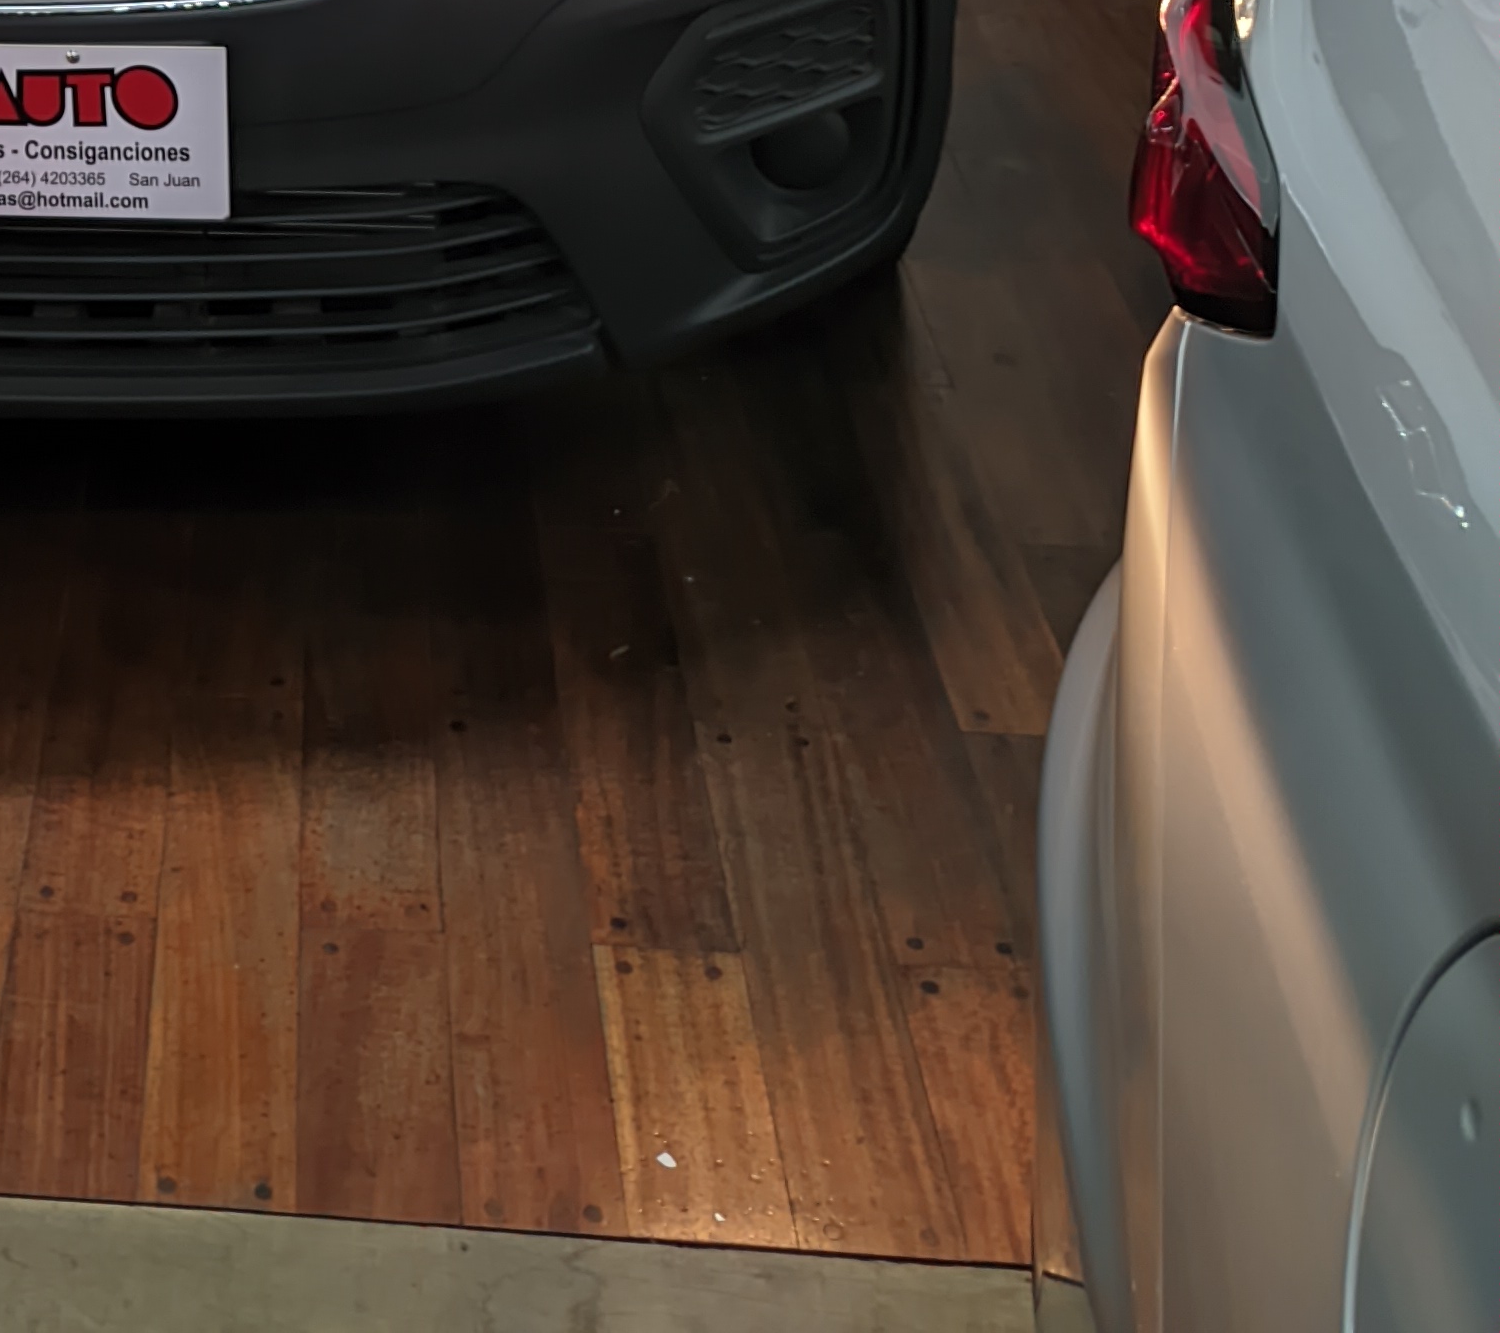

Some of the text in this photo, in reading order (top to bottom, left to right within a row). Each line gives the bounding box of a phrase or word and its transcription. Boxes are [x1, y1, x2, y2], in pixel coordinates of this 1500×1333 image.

[24, 139, 190, 165] Consiganciones
[40, 171, 106, 186] 4203365
[128, 173, 159, 187] San
[163, 173, 201, 188] Juan
